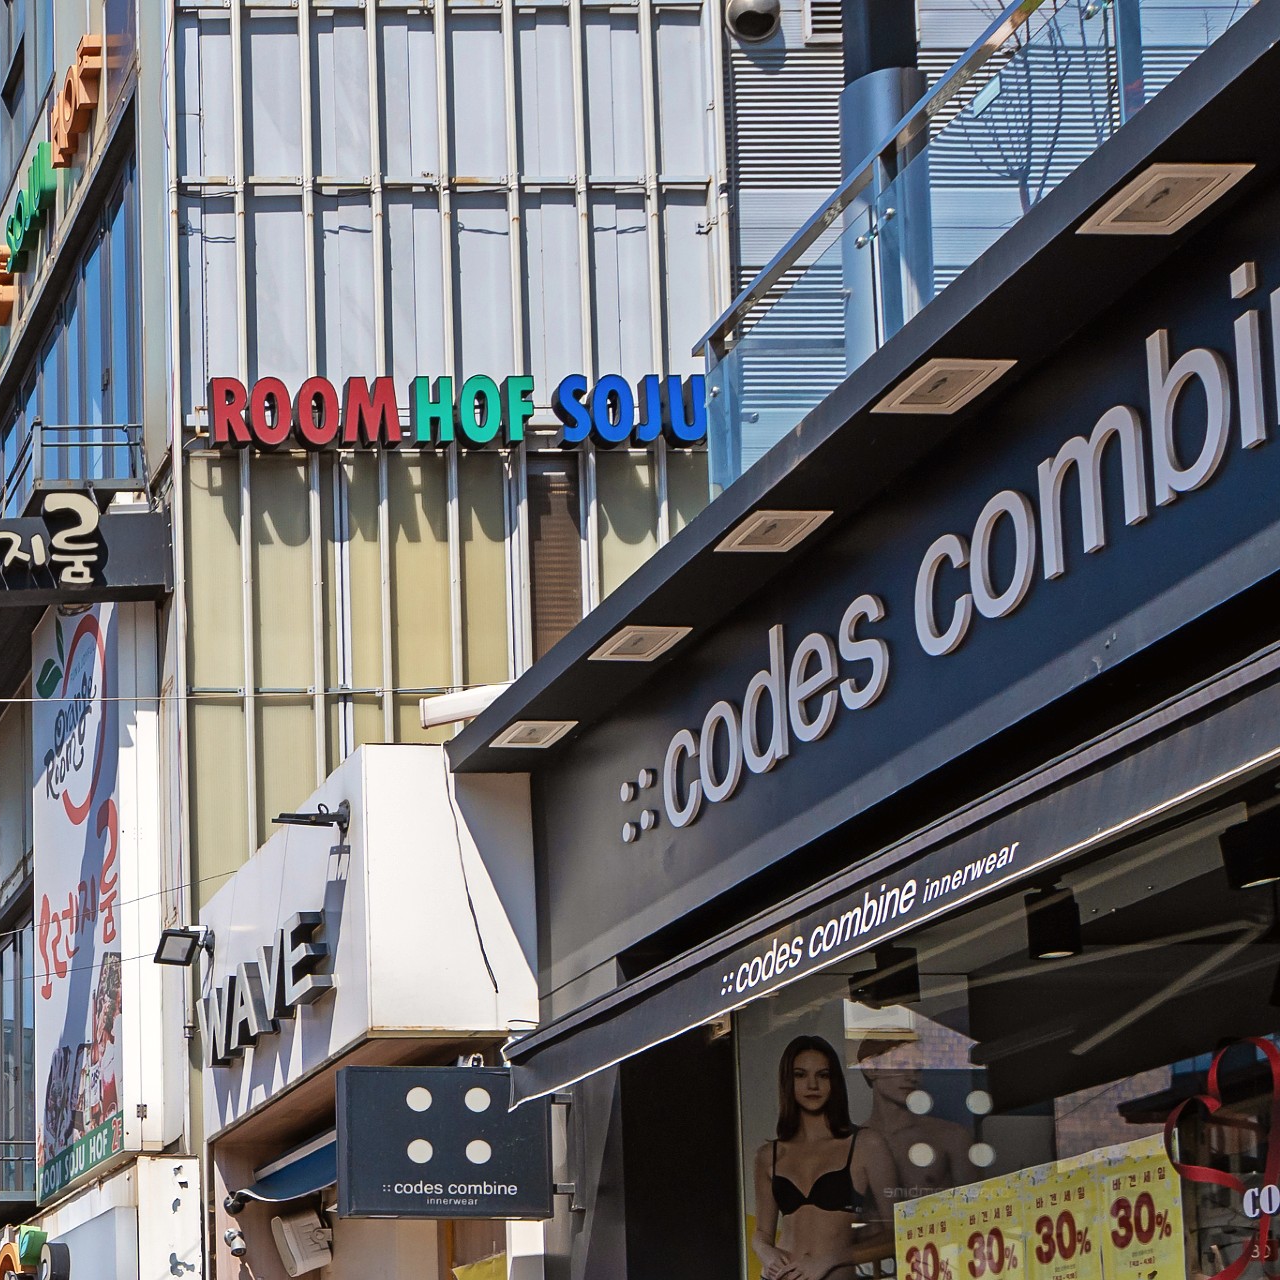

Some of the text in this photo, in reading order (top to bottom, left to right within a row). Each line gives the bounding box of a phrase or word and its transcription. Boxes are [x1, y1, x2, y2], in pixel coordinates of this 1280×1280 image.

[208, 374, 707, 450] ROOM HOF SOJU
[661, 261, 1280, 828] codes combi
[55, 676, 97, 753] Orange
[735, 841, 1020, 993] codes combine innerwear
[196, 910, 339, 1068] WAVE
[65, 1144, 85, 1180] SOJU
[90, 1128, 108, 1164] HOF
[394, 1181, 518, 1195] codes combine
[426, 1197, 478, 1206] innerwear
[1035, 1209, 1091, 1265] 30%
[1110, 1191, 1172, 1250] 30%
[967, 1226, 1018, 1279] 30%
